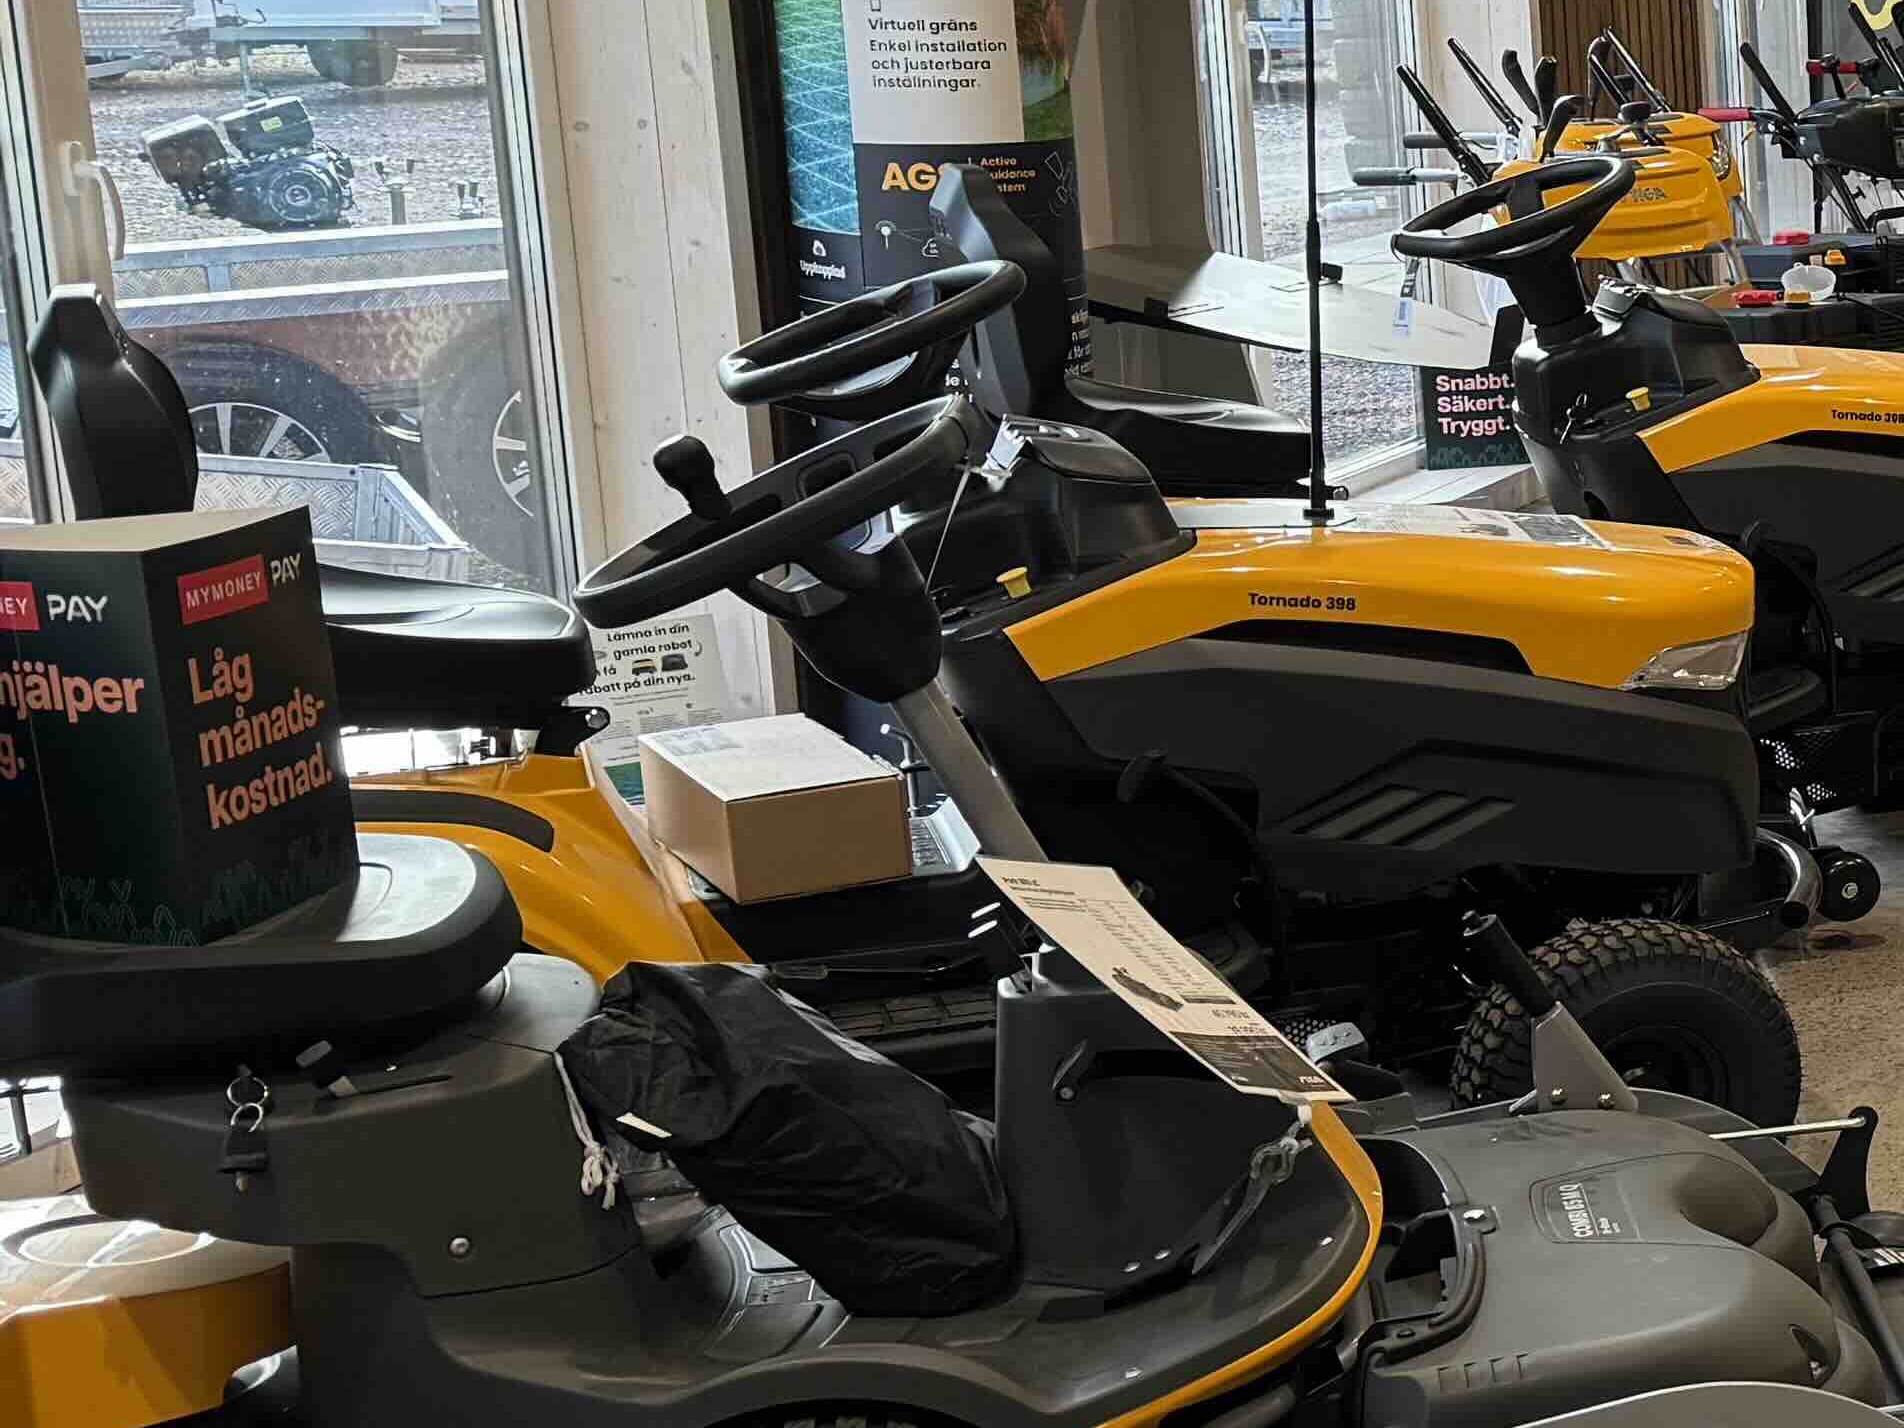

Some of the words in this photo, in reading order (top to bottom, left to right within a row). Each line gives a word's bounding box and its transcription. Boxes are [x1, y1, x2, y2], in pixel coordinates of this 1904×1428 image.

[868, 18, 925, 31] Virtuell
[929, 18, 978, 35] gräns
[869, 39, 911, 52] Enkel
[915, 39, 1007, 52] installation
[871, 57, 900, 69] och
[904, 57, 991, 73] justerbara
[873, 75, 981, 92] inställningar.
[881, 162, 945, 192] AG
[980, 156, 1017, 166] Active
[1435, 372, 1516, 392] Snabbt.
[1437, 394, 1511, 412] Säkert.
[1832, 409, 1882, 422] Tornado
[1437, 415, 1511, 438] Tryggt.
[185, 571, 264, 611] MYMONEY
[270, 554, 301, 586] PAY
[46, 594, 108, 622] PAY
[1248, 592, 1322, 608] Tornado
[1326, 596, 1356, 611] 398
[654, 626, 667, 637] in
[669, 623, 690, 635] din
[613, 644, 656, 661] gamla
[188, 647, 255, 705] Låg
[623, 678, 642, 693] på
[644, 675, 665, 687] din
[667, 671, 696, 686] nya.
[199, 686, 326, 767] månads-
[206, 741, 335, 830] kostnad.
